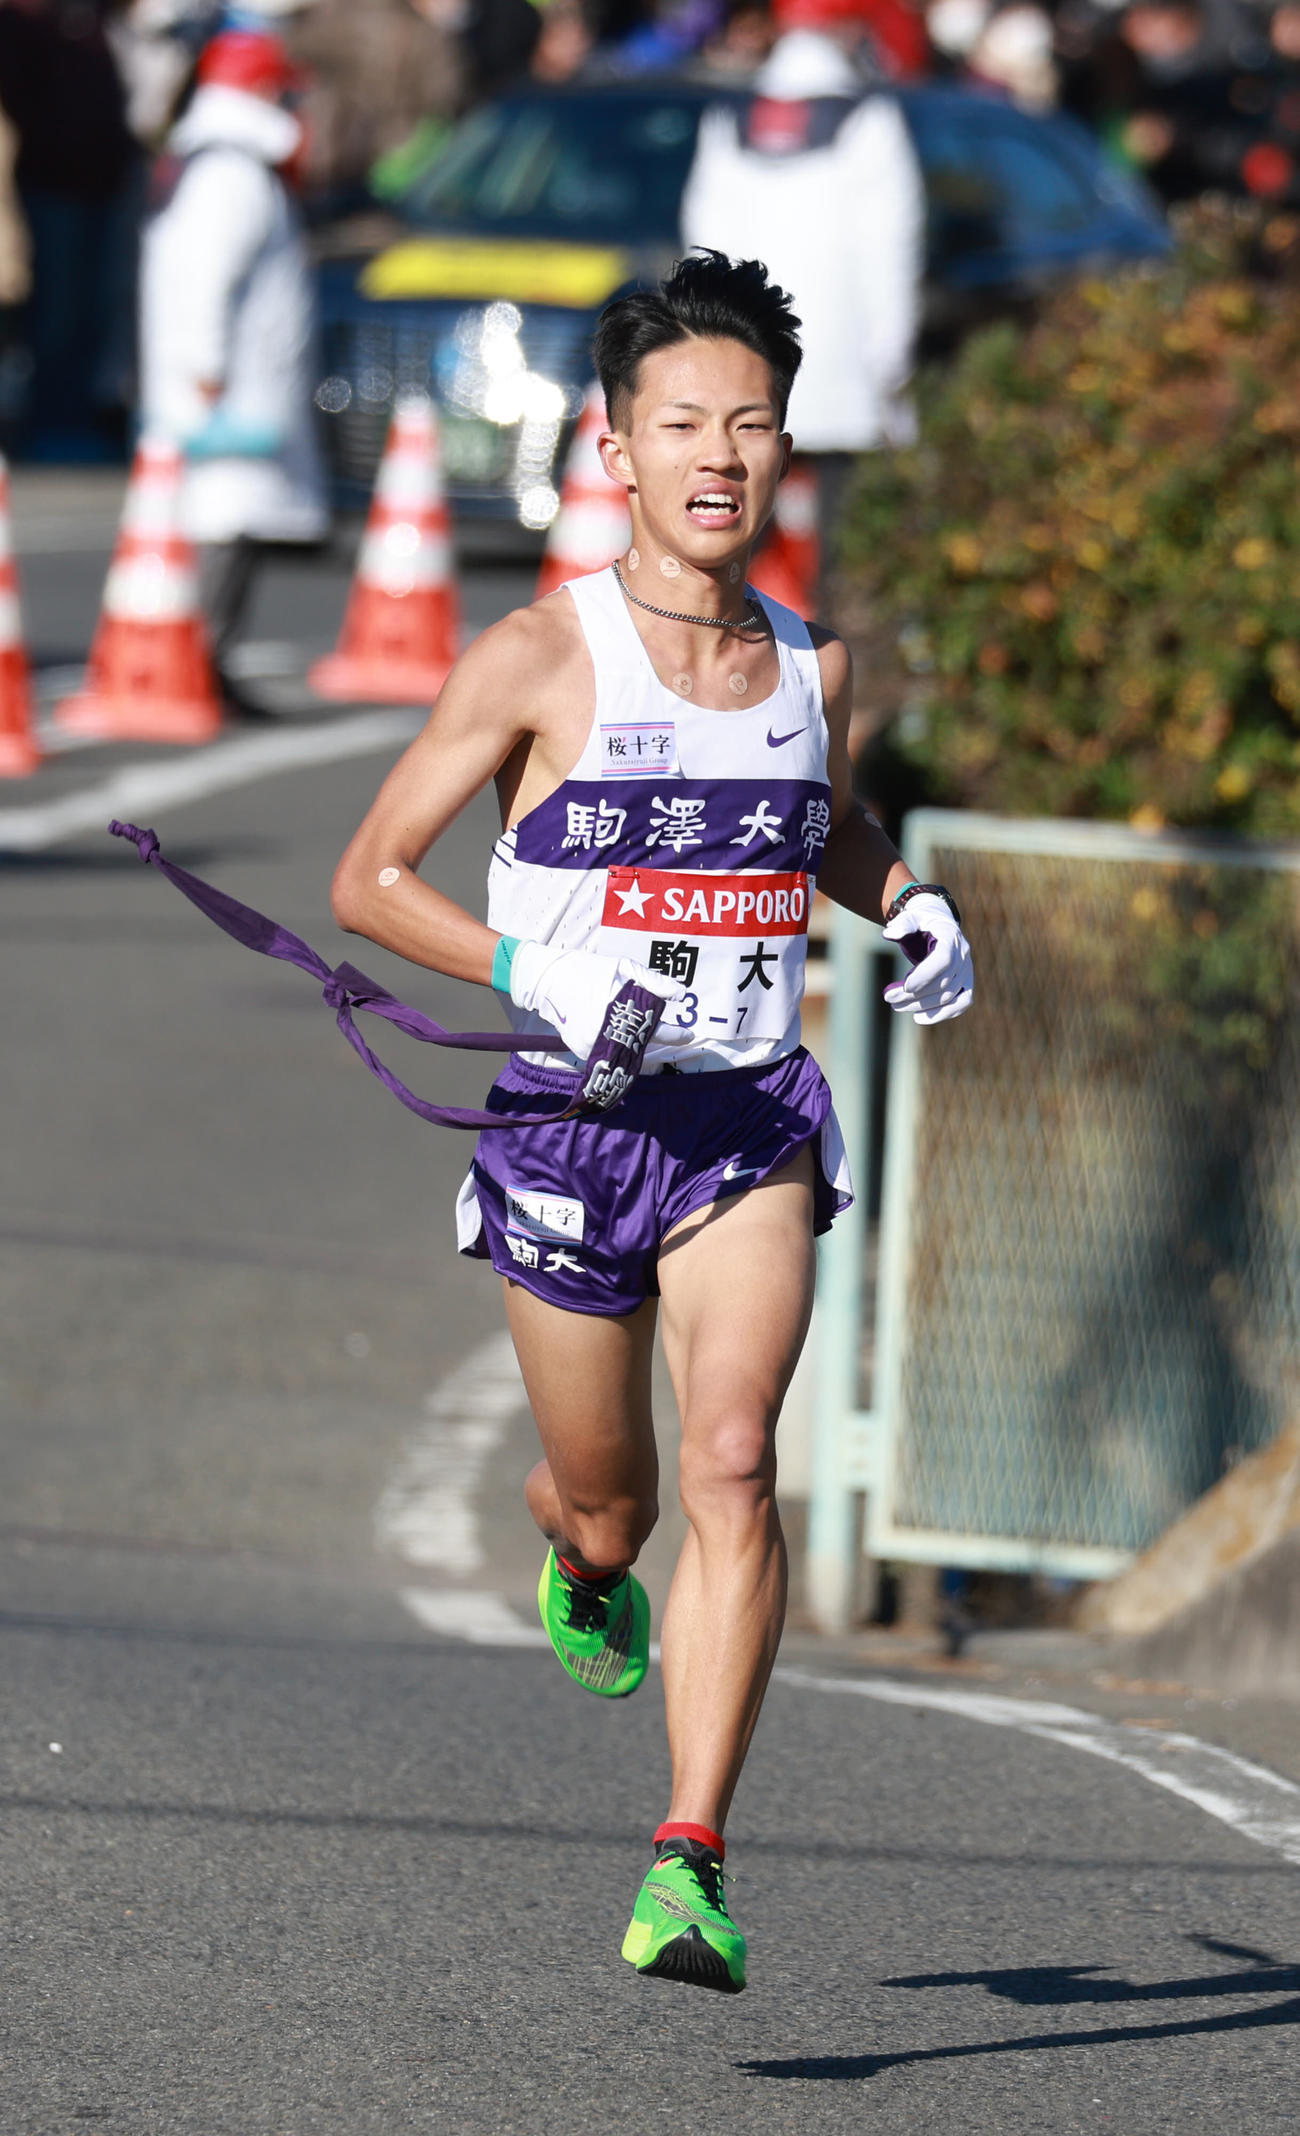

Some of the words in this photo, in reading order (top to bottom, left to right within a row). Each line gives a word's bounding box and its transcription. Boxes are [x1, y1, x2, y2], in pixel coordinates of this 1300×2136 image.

[607, 734, 671, 757] 桜十字
[661, 887, 805, 924] SAPPORO
[511, 1198, 577, 1226] 桜十字
